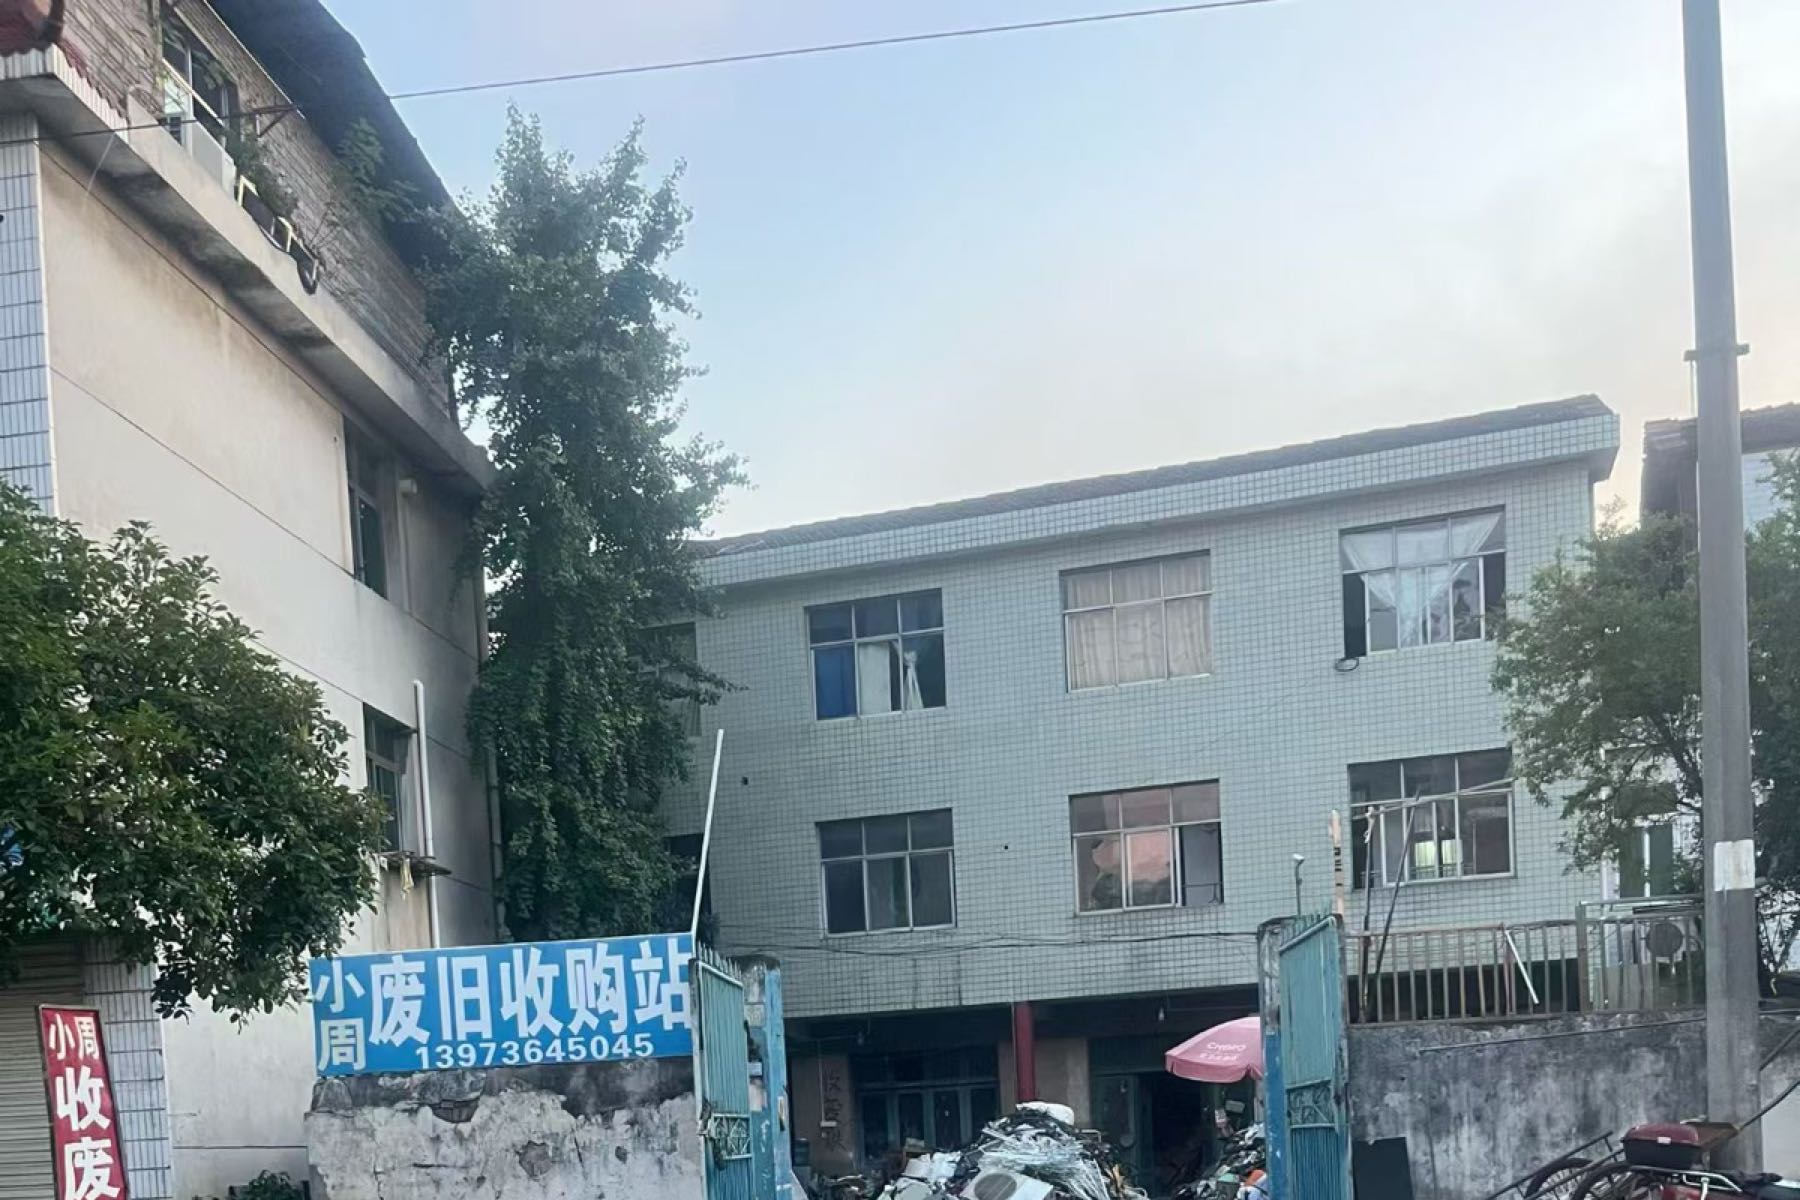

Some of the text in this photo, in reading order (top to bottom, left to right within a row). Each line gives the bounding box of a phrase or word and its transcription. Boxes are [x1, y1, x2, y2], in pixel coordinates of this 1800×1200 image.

[314, 958, 367, 1071] 小周
[368, 937, 692, 1047] 废旧收购站
[48, 1013, 100, 1061] 小周
[415, 1032, 655, 1069] 13973645045
